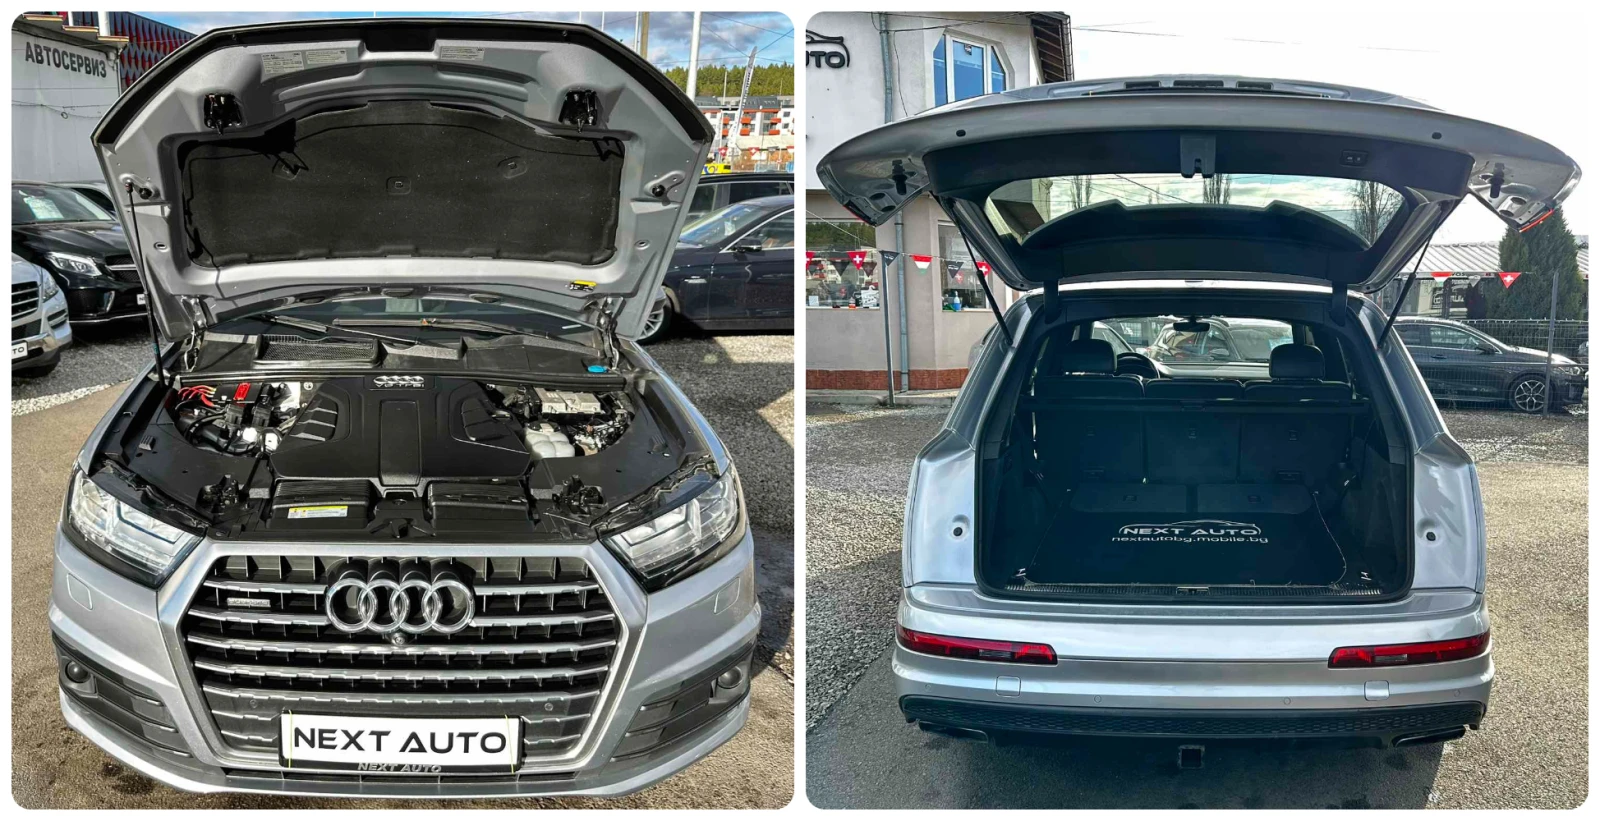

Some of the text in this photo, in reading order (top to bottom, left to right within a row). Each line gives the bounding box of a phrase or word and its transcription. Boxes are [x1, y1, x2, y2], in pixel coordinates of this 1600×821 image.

[25, 41, 107, 78] АВТОСЕРВИЗ
[806, 50, 846, 69] TO
[294, 727, 507, 754] NEXT AUTO
[358, 762, 442, 773] NEXT AUTO
